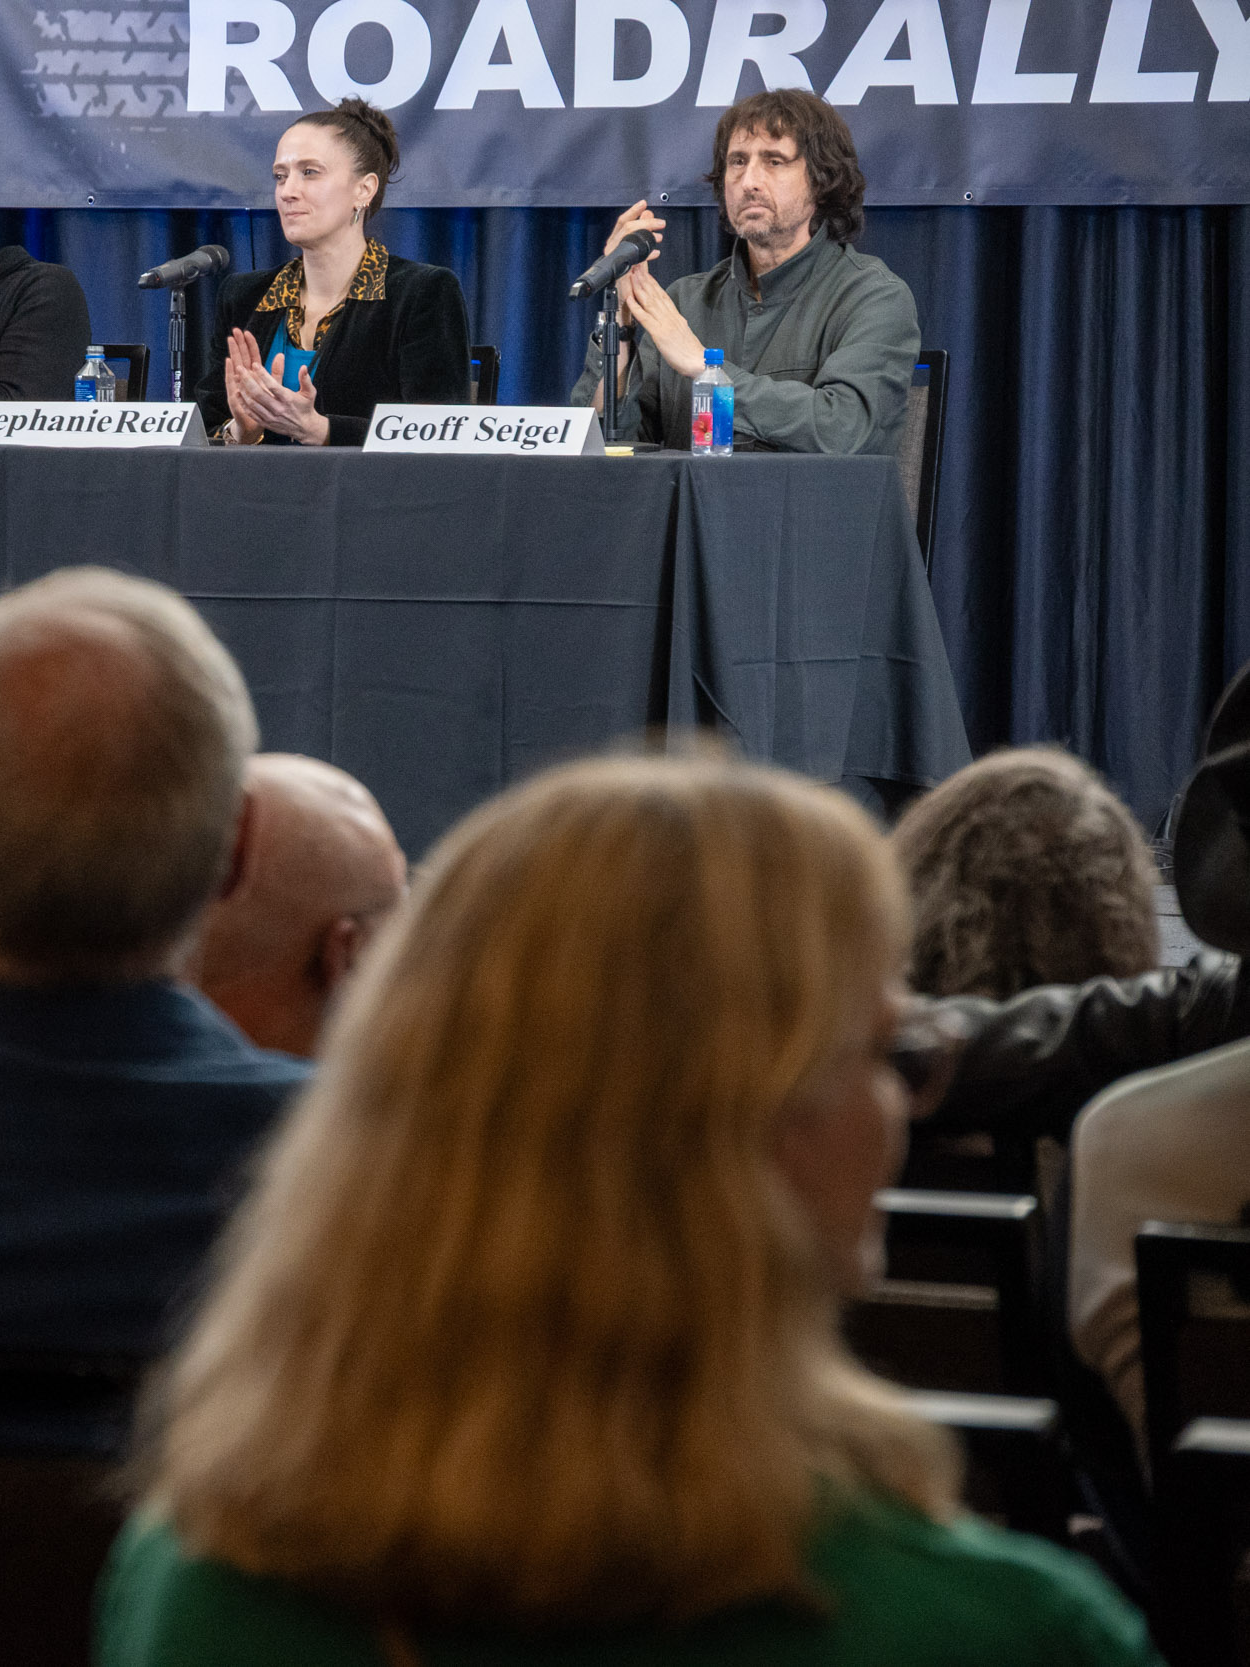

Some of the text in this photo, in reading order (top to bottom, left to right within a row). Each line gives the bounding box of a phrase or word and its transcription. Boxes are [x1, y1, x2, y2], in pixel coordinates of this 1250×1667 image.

[693, 396, 711, 413] FIJI
[114, 410, 189, 433] Reid
[375, 415, 572, 450] Geoff Seigel
